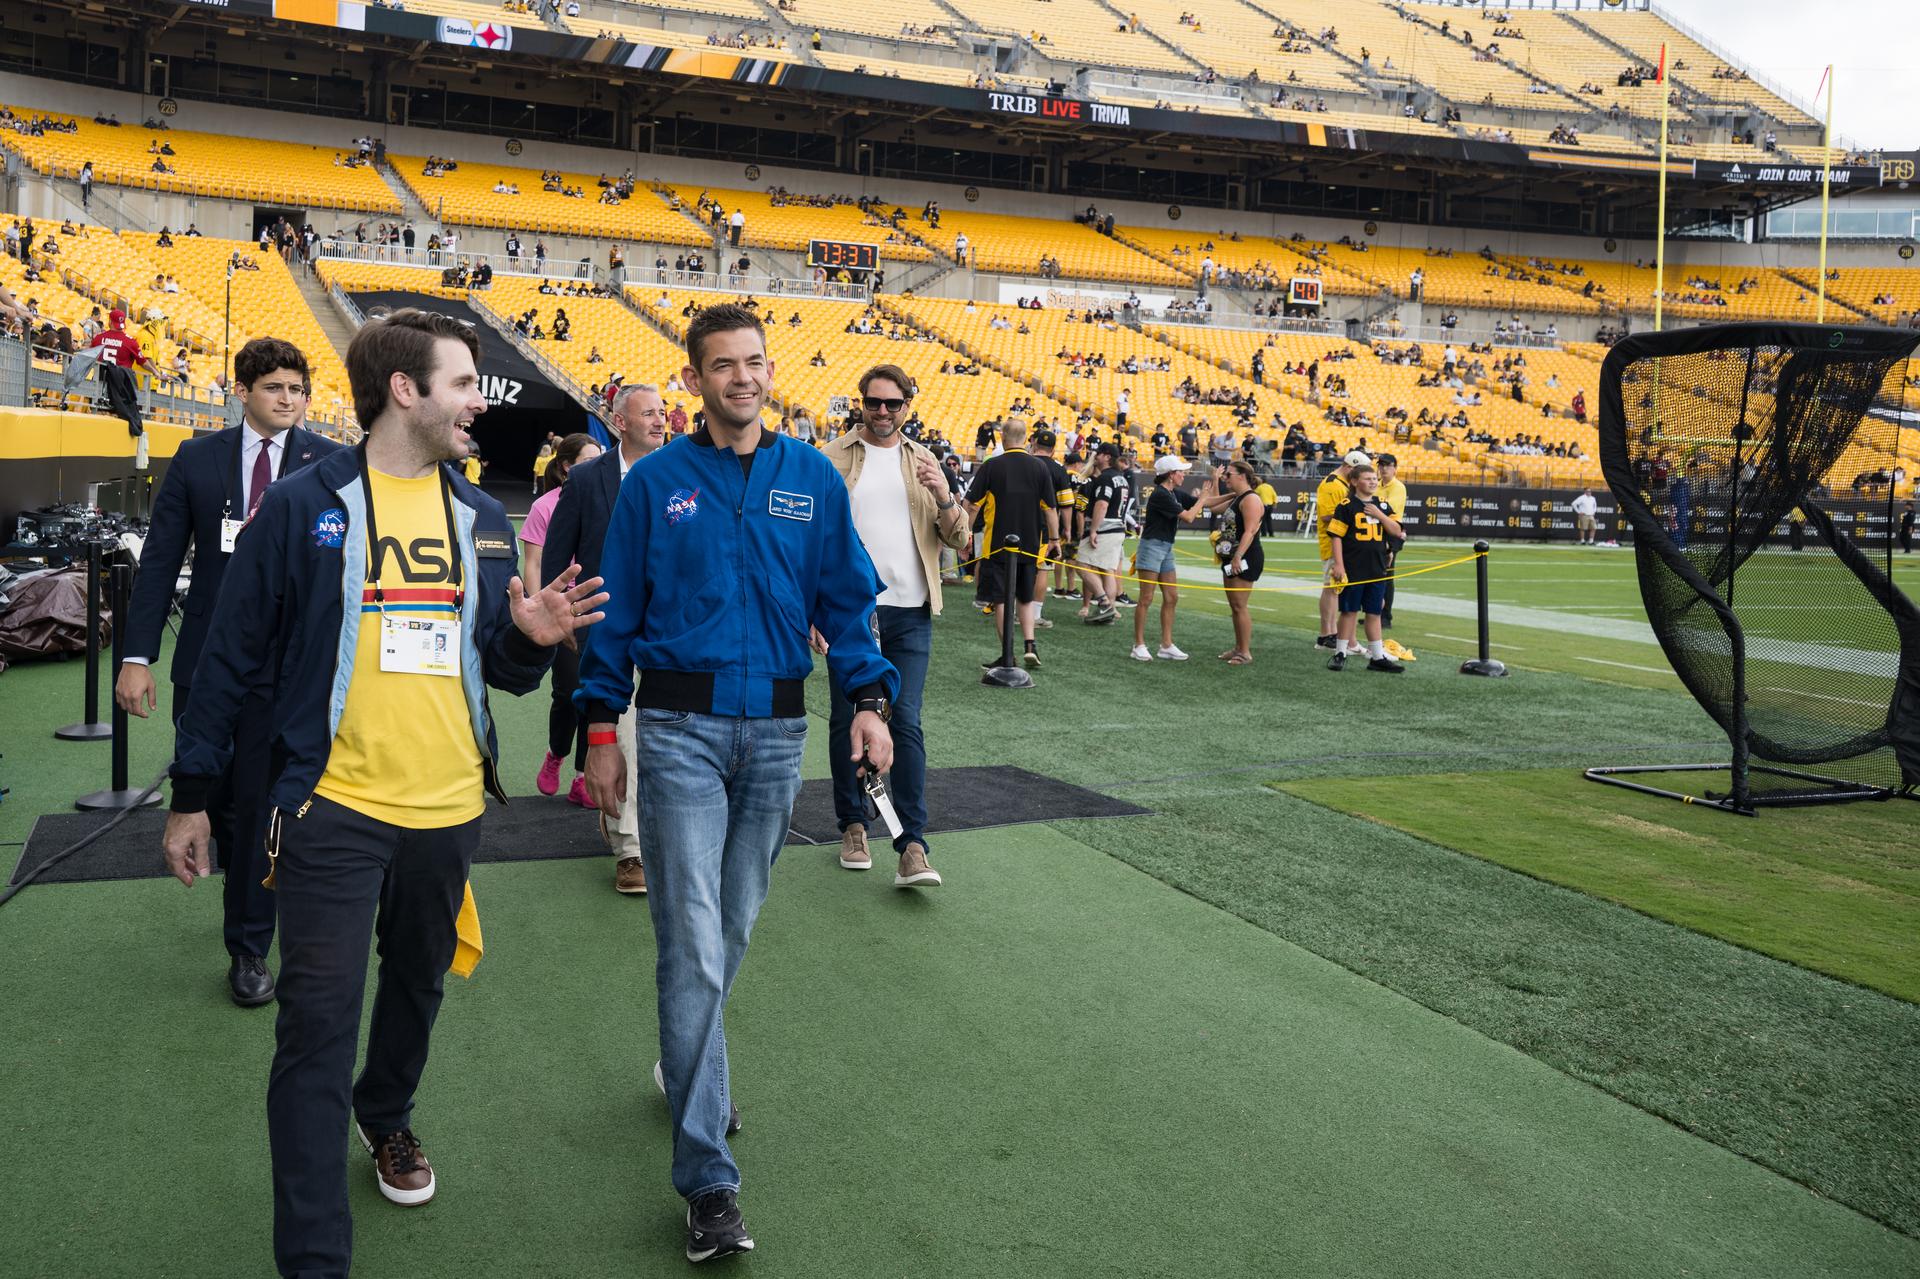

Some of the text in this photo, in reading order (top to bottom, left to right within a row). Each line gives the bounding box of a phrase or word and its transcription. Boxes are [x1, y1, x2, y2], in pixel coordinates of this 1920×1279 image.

[446, 25, 472, 36] Steelers
[160, 103, 176, 114] 226
[989, 93, 1130, 126] TRIB LIVE TRIVIA
[1756, 168, 1784, 182] JOIN
[1787, 169, 1813, 183] OUR
[818, 242, 872, 268] 73:37
[1295, 282, 1318, 301] 40
[102, 337, 123, 347] LONDON
[103, 348, 117, 366] 5
[474, 374, 523, 405] INZ
[1297, 491, 1309, 503] 26
[1426, 496, 1437, 507] 42
[666, 500, 698, 515] NASA
[1461, 498, 1473, 509] 34
[1542, 500, 1552, 512] 20
[1427, 513, 1436, 524] 31
